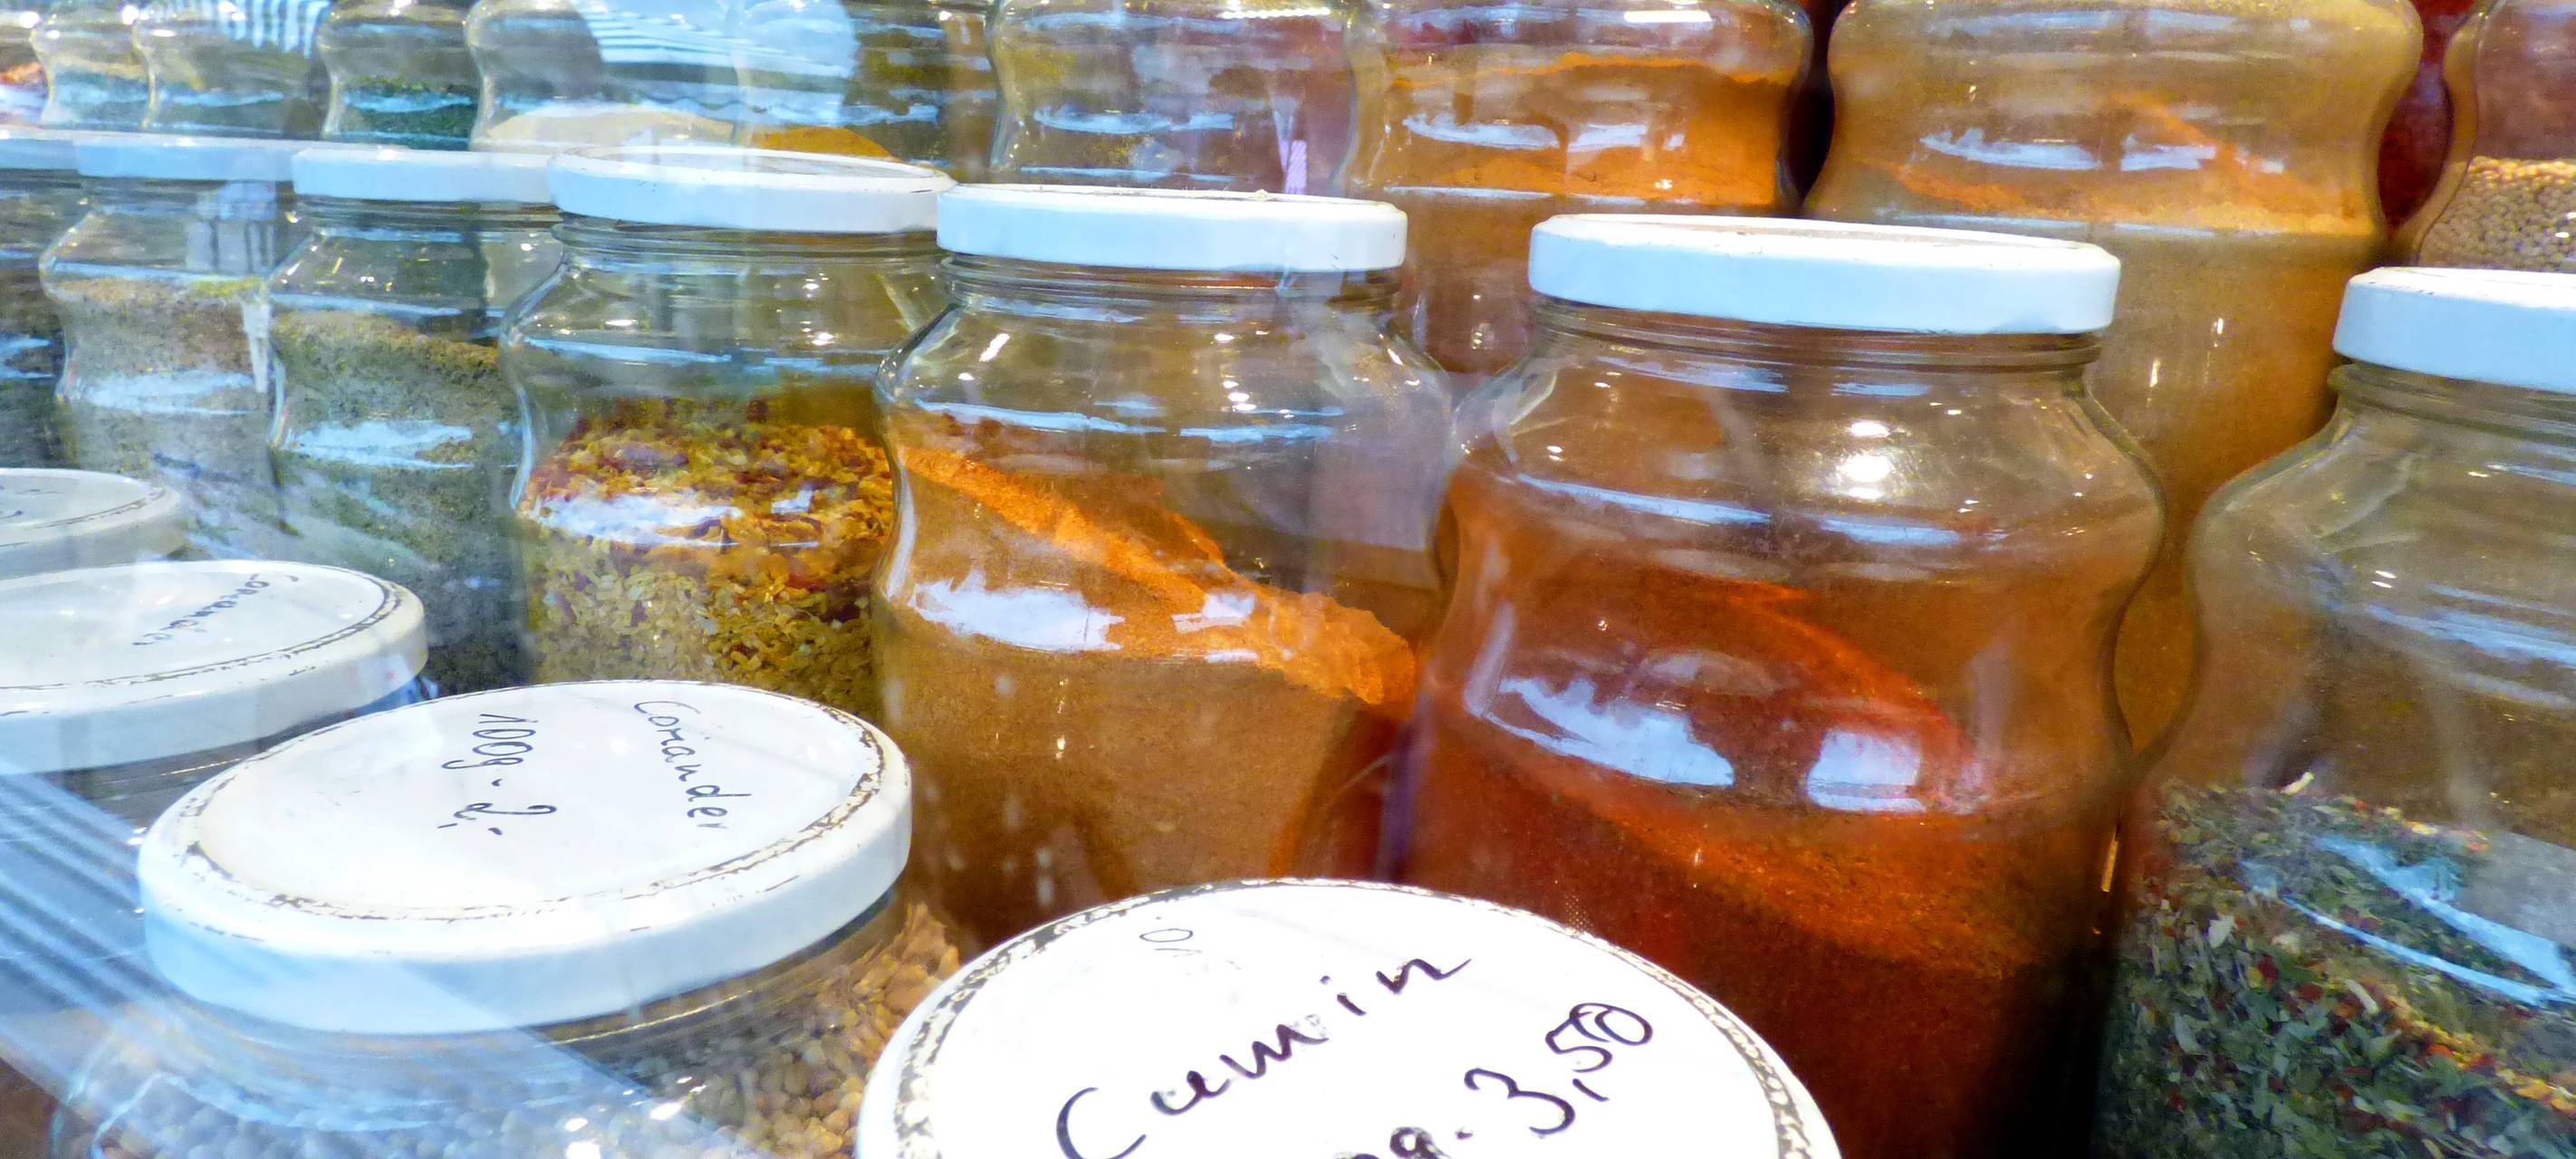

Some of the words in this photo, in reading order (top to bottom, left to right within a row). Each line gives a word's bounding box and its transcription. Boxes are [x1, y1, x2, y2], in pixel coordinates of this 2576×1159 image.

[634, 701, 752, 829] Coriander
[1056, 958, 1473, 1159] Cumin
[1464, 1002, 1654, 1135] 3,50
